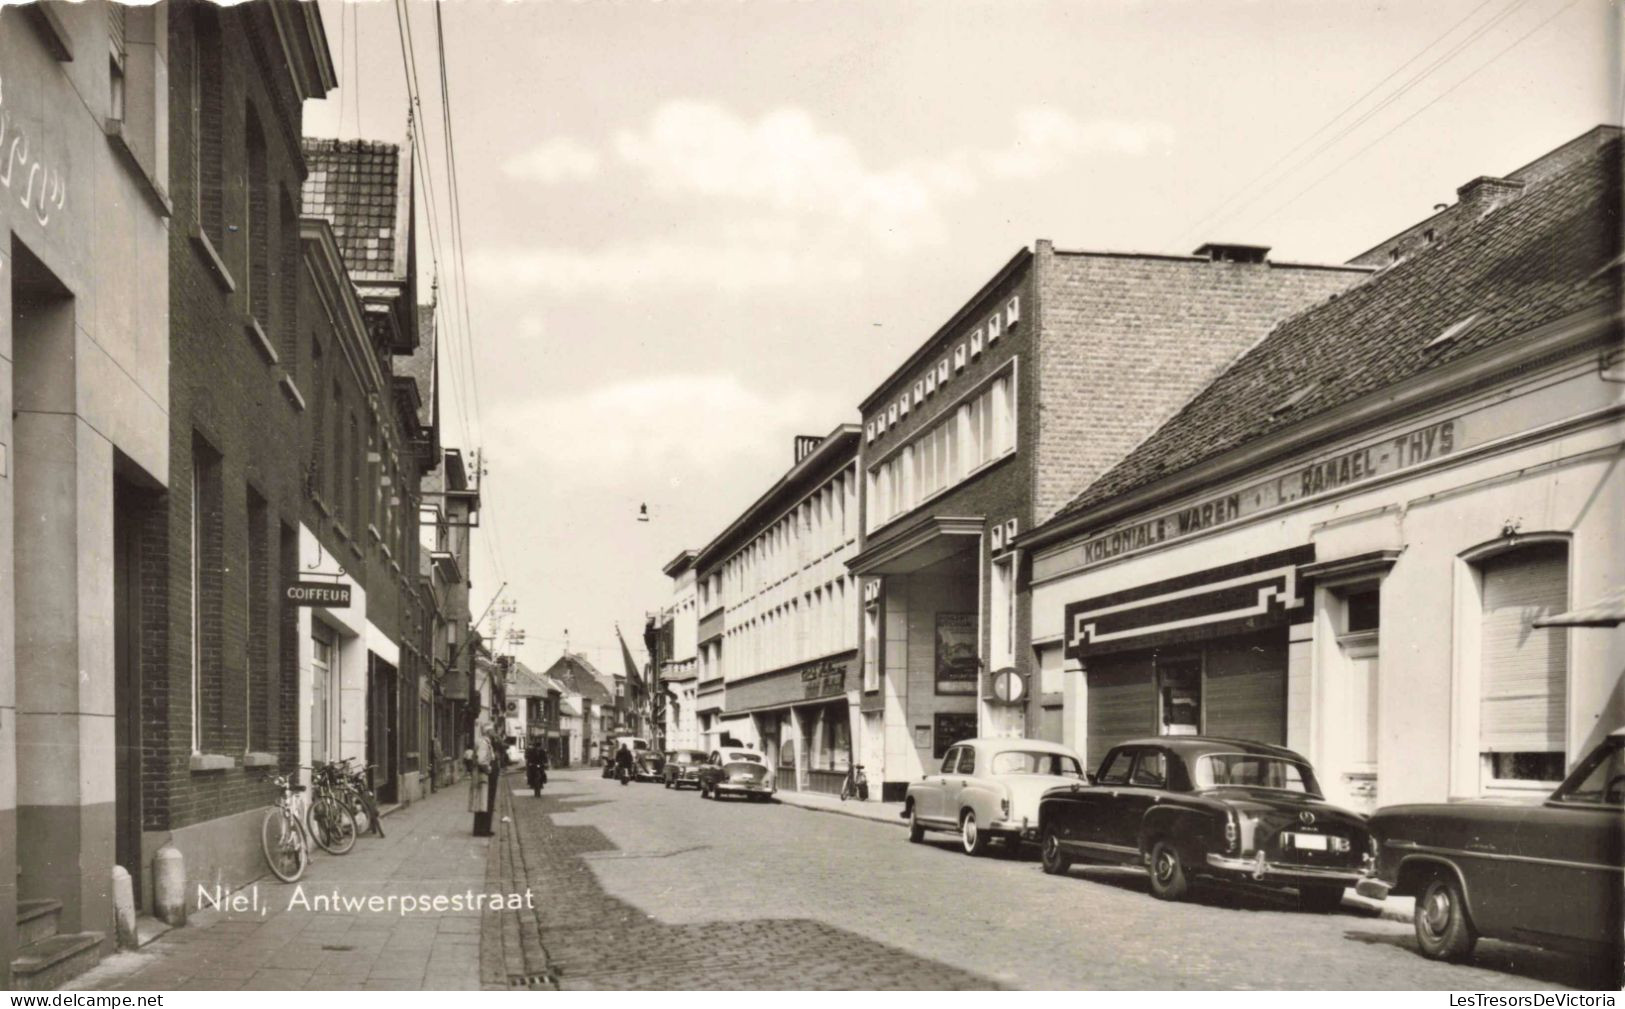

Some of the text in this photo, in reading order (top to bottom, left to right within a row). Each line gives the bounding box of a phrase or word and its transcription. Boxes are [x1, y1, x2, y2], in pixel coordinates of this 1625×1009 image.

[1084, 518, 1165, 564] KOLONIALE
[1177, 494, 1240, 533] WAREN
[1301, 449, 1376, 497] RAMAEL
[287, 587, 349, 601] COIFFEUR
